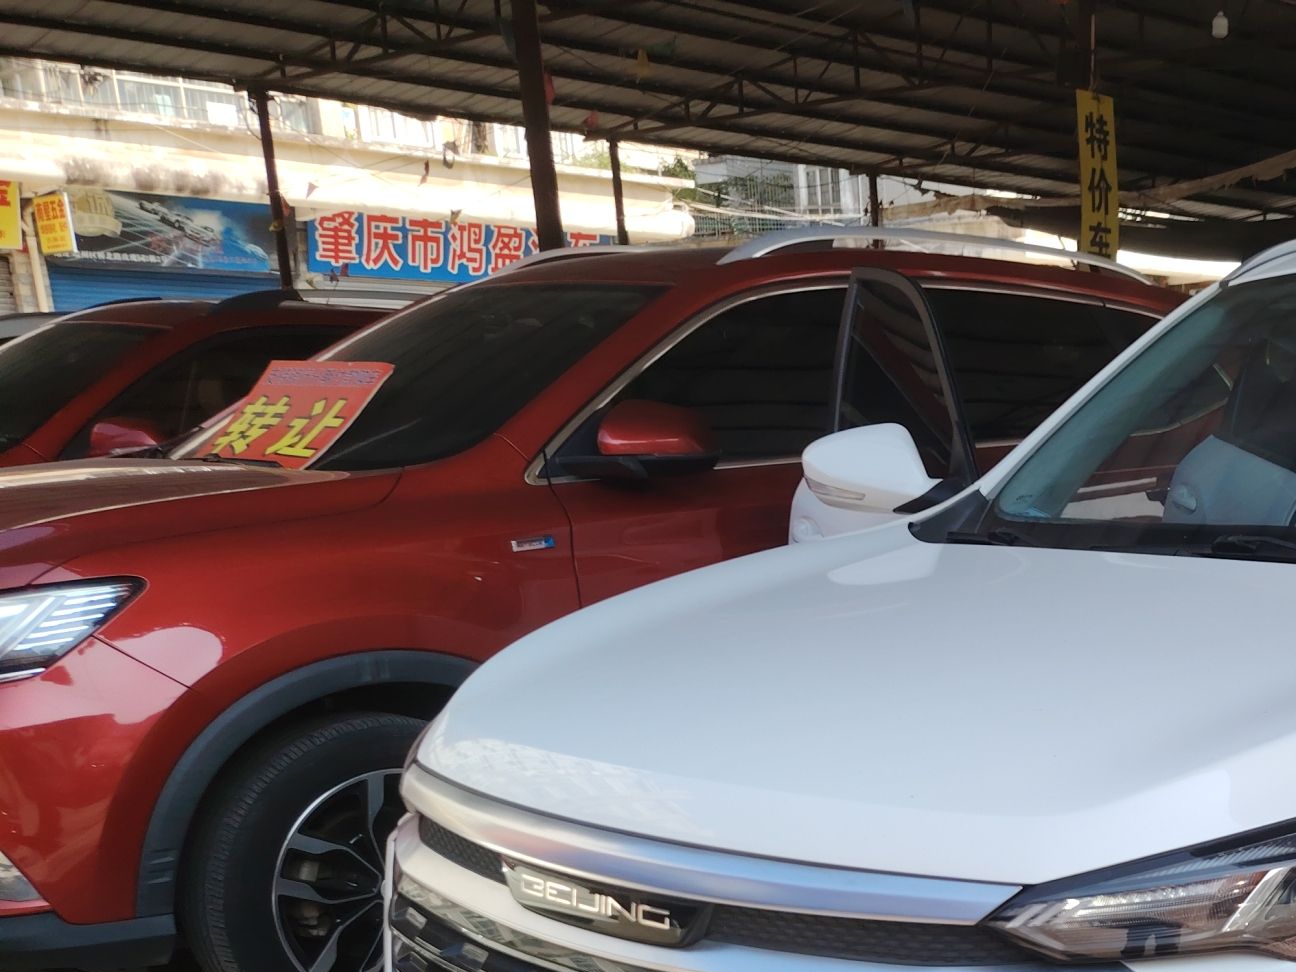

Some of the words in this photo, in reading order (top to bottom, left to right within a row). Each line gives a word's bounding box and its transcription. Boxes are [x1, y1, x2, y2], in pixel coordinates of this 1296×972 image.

[1084, 111, 1112, 259] 特价车
[315, 210, 598, 273] 肇庆市鸿盈
[211, 395, 347, 457] 转让
[520, 873, 671, 930] BEIJING
